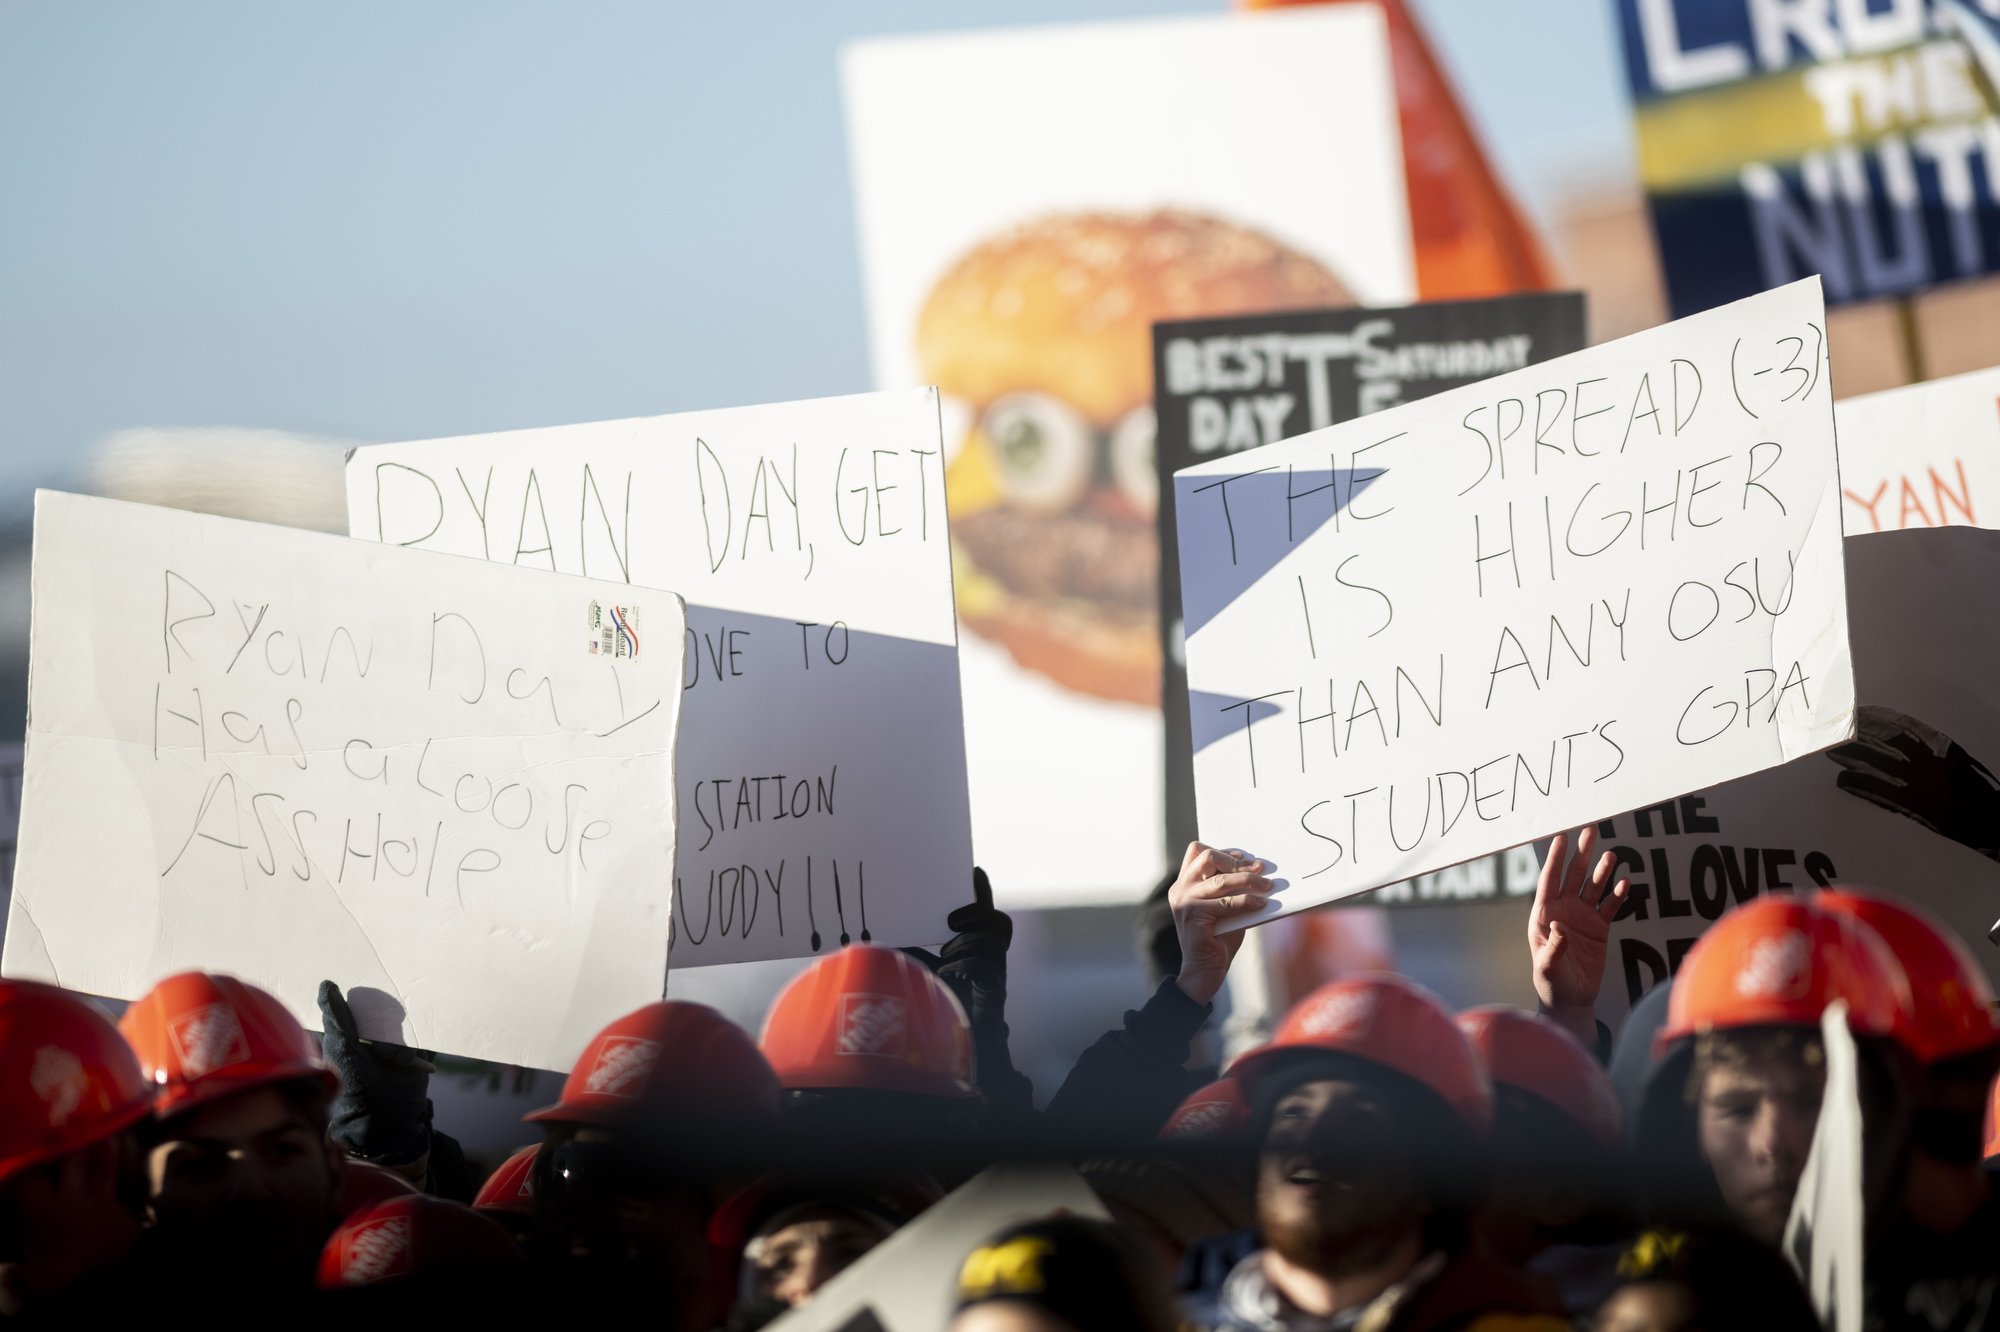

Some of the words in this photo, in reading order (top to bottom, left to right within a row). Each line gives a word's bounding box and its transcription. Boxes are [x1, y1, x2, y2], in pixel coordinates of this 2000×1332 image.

[1804, 38, 1980, 138] THE
[1739, 115, 2000, 303] NUT
[1163, 333, 1289, 394] BEST
[1188, 393, 1295, 454] DAY
[1193, 432, 1408, 565] THE
[1458, 359, 1702, 497] SPREAD
[1732, 322, 1821, 419] (-3)
[696, 437, 814, 581] DAY,
[835, 447, 938, 546] GET
[1298, 554, 1393, 659] IS
[1475, 442, 1787, 598] HIGHER
[796, 620, 849, 670] TO
[1220, 654, 1443, 788] THAN
[1485, 587, 1631, 710] ANY
[1669, 551, 1795, 642] OSU
[695, 764, 837, 852] STATION
[1301, 720, 1624, 880] STUDENT'S
[1676, 661, 1810, 746] GPA
[671, 855, 872, 952] UDDY!!!
